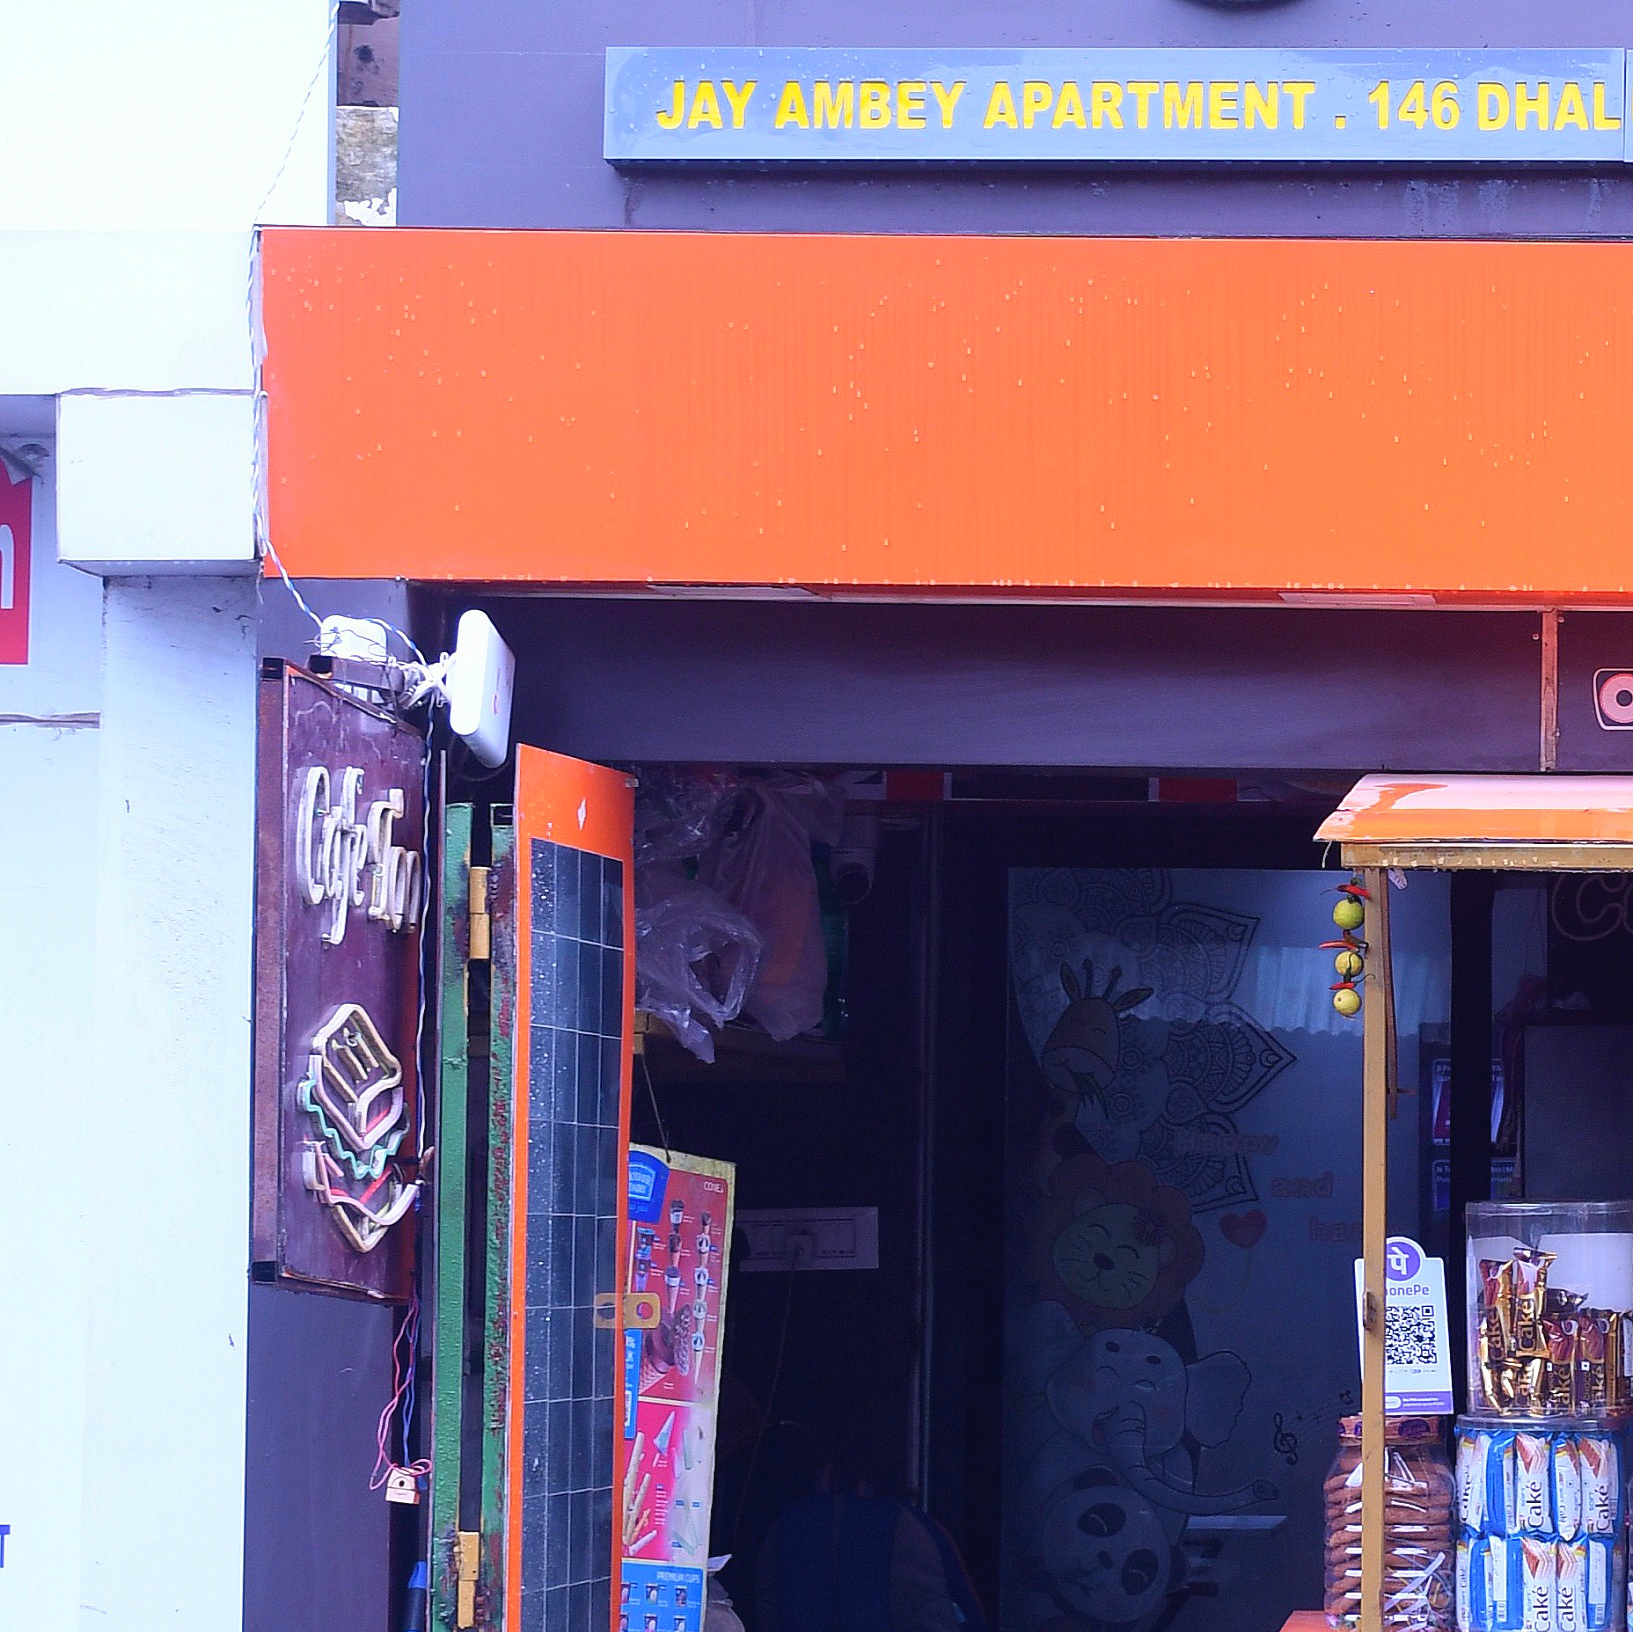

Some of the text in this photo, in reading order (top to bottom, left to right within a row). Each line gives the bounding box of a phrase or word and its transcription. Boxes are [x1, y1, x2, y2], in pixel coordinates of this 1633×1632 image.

[656, 80, 756, 129] JAY
[773, 80, 965, 129] AMBEY
[983, 81, 1316, 130] APARTMENT
[1368, 80, 1461, 130] 146
[1386, 1284, 1430, 1297] onePe
